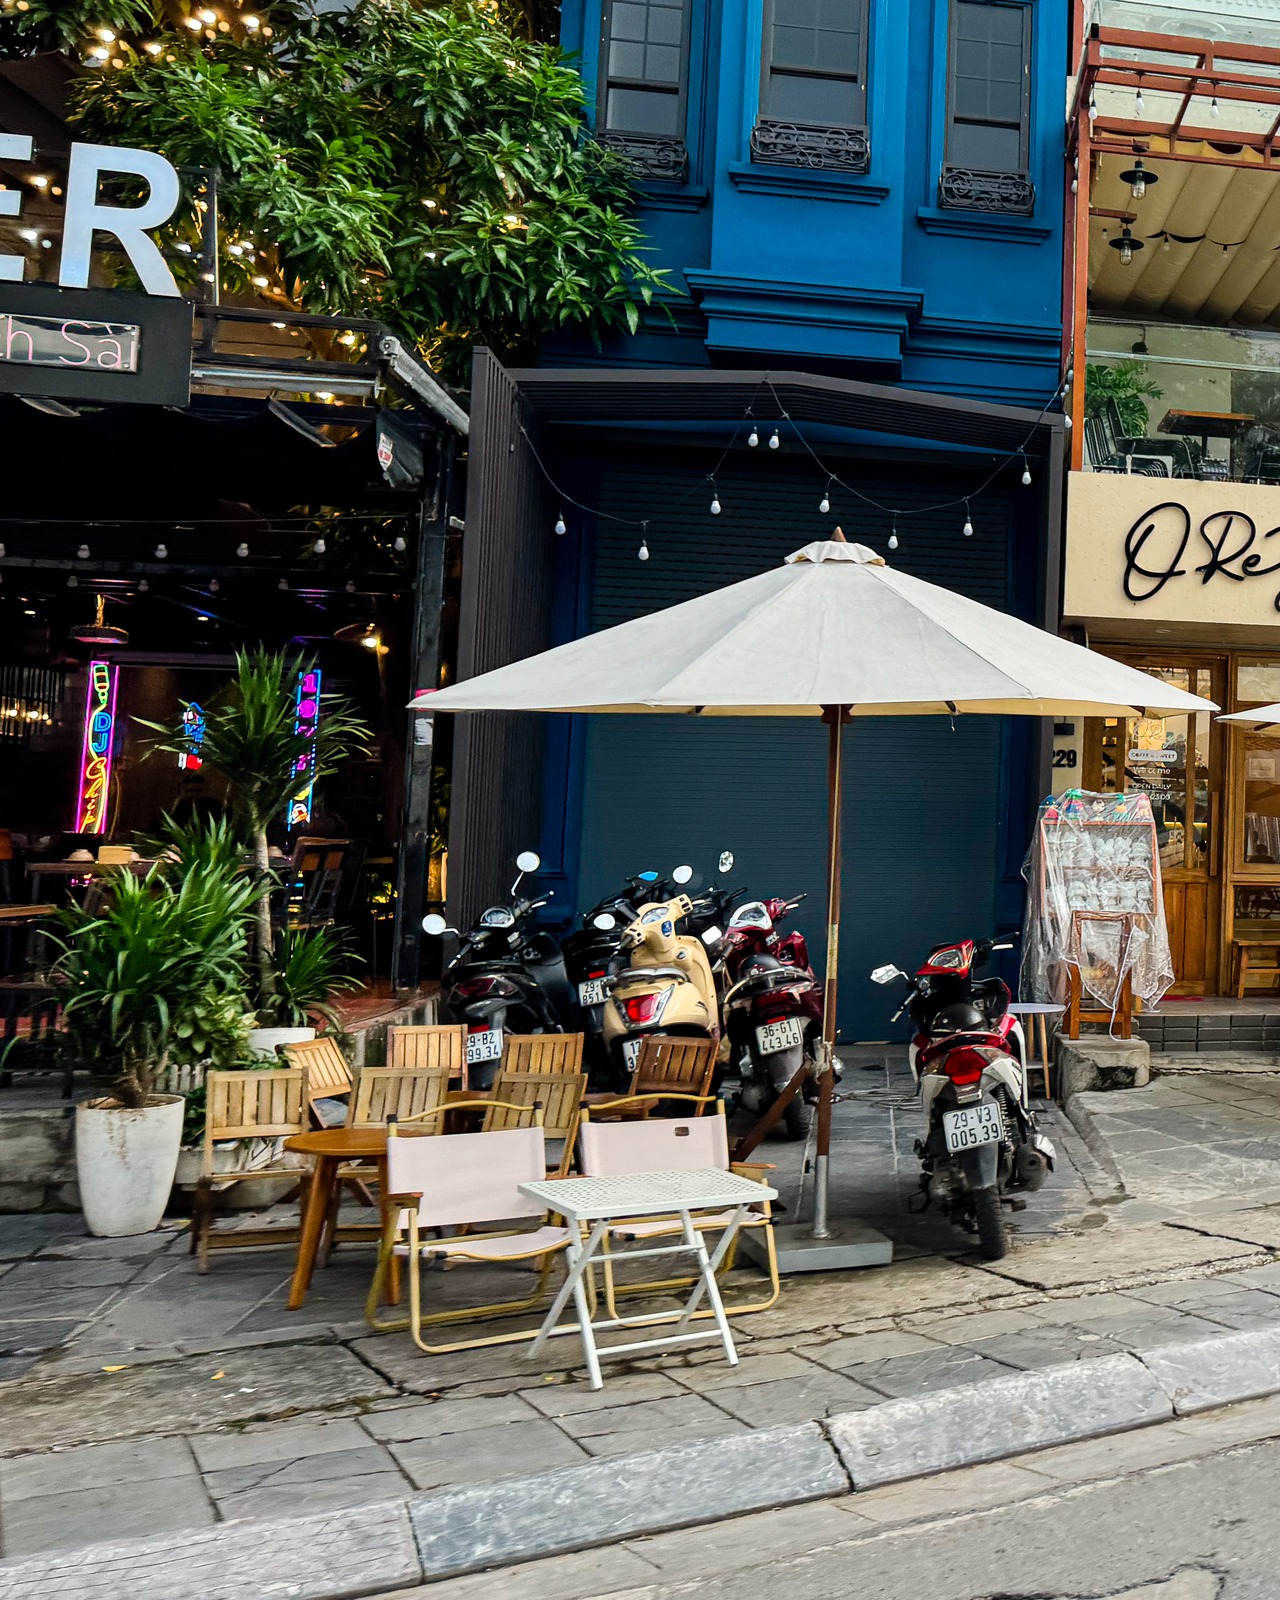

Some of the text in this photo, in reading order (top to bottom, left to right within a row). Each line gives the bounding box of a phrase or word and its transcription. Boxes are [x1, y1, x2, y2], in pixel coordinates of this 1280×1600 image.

[92, 712, 112, 753] DJ
[1053, 750, 1077, 767] 29
[761, 1021, 792, 1039] 36-G1
[466, 1032, 495, 1048] 9-B2
[762, 1033, 799, 1052] 443.46
[467, 1045, 499, 1061] 99.34
[952, 1106, 992, 1130] 29-V3
[951, 1123, 999, 1148] 005.39
